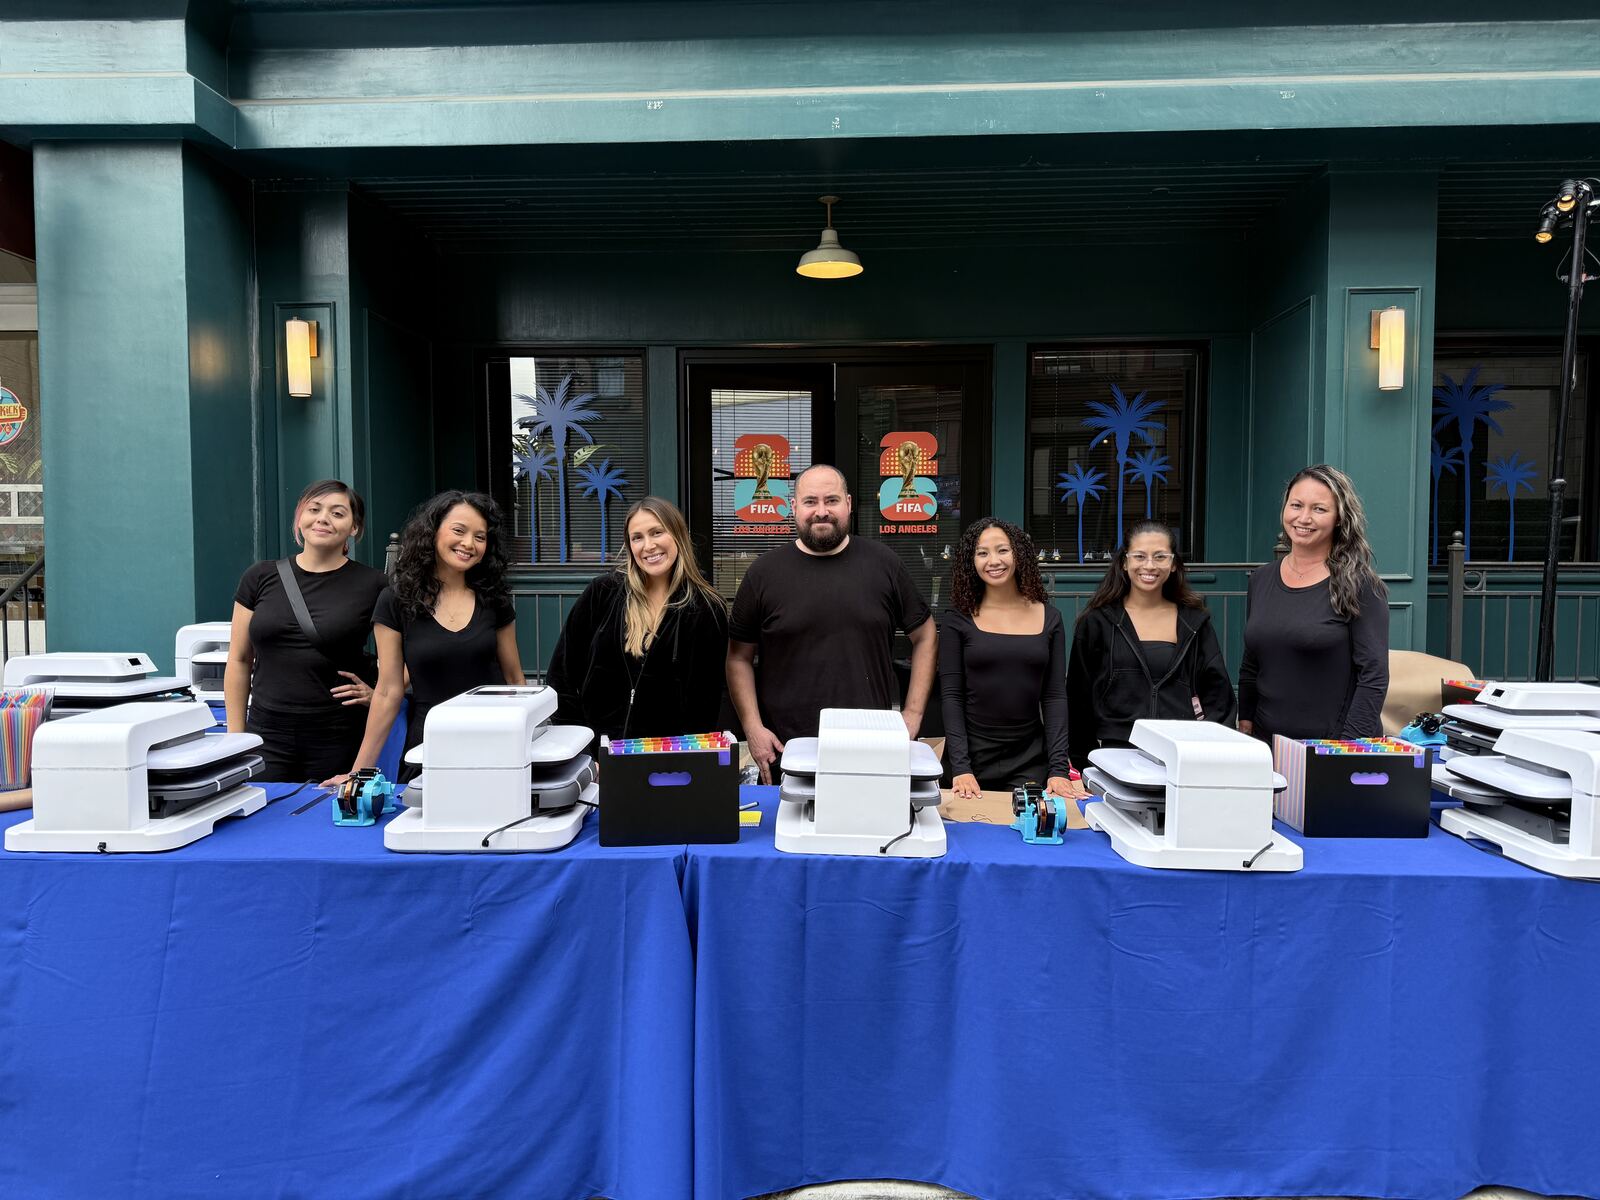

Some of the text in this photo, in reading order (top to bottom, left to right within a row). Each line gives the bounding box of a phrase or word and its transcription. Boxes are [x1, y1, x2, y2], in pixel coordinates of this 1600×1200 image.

[750, 504, 776, 514] FIFA
[896, 503, 922, 513] FIFA
[880, 525, 938, 534] LOS ANGELES
